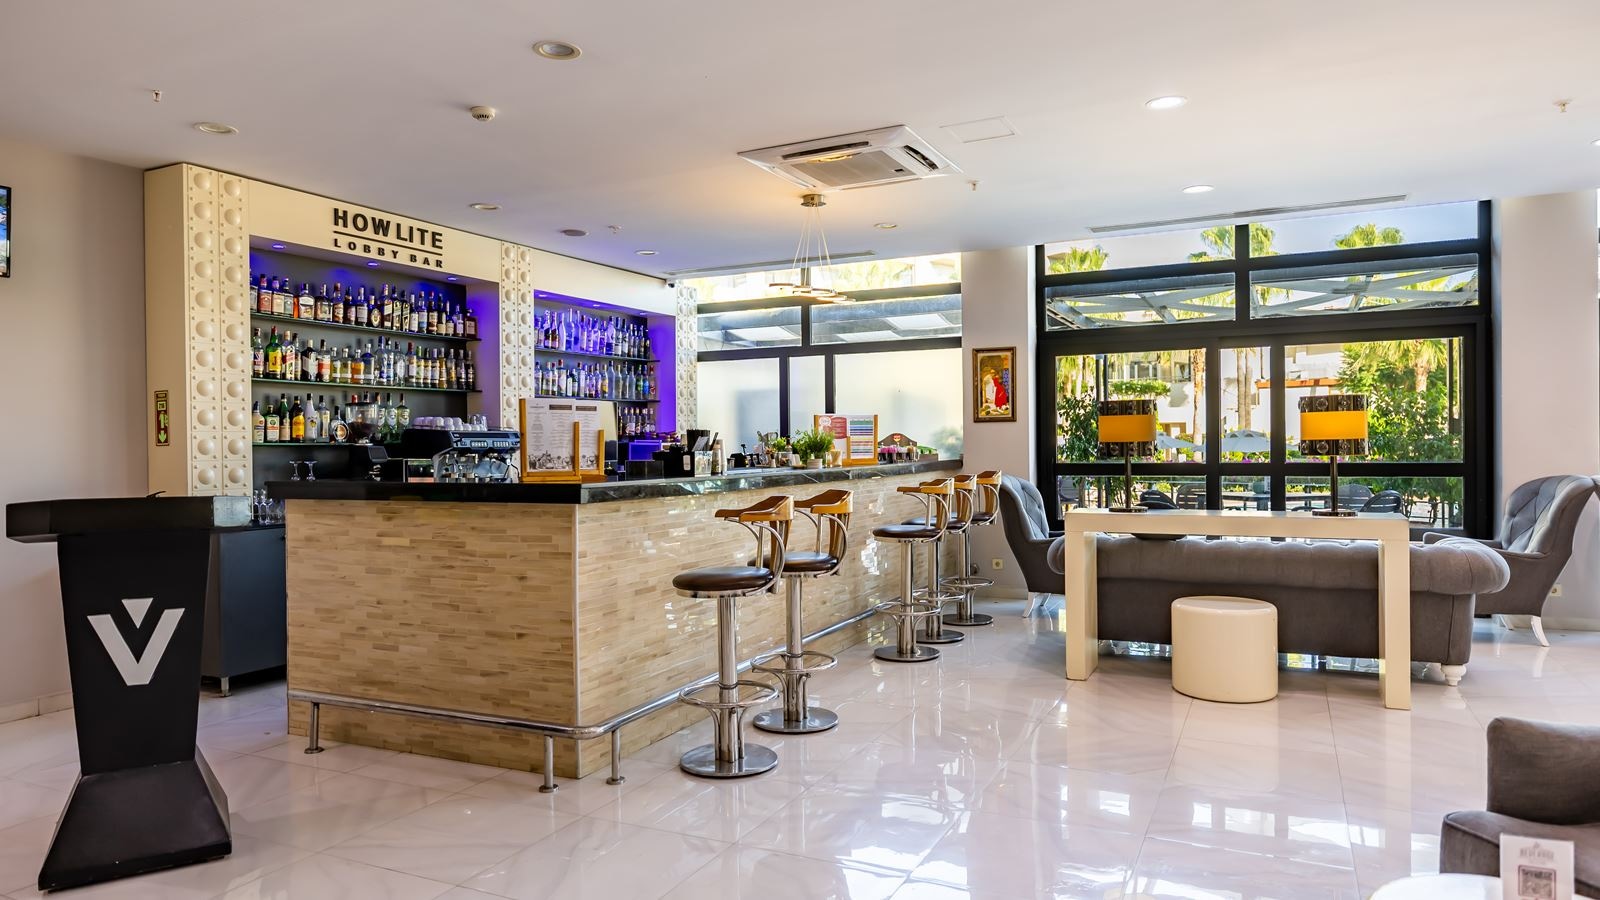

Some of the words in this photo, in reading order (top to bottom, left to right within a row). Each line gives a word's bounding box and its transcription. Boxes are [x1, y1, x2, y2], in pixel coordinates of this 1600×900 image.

[333, 208, 443, 250] HOWLITE
[334, 238, 399, 259] LOBBY
[410, 254, 443, 269] BAR
[87, 598, 186, 686] V
